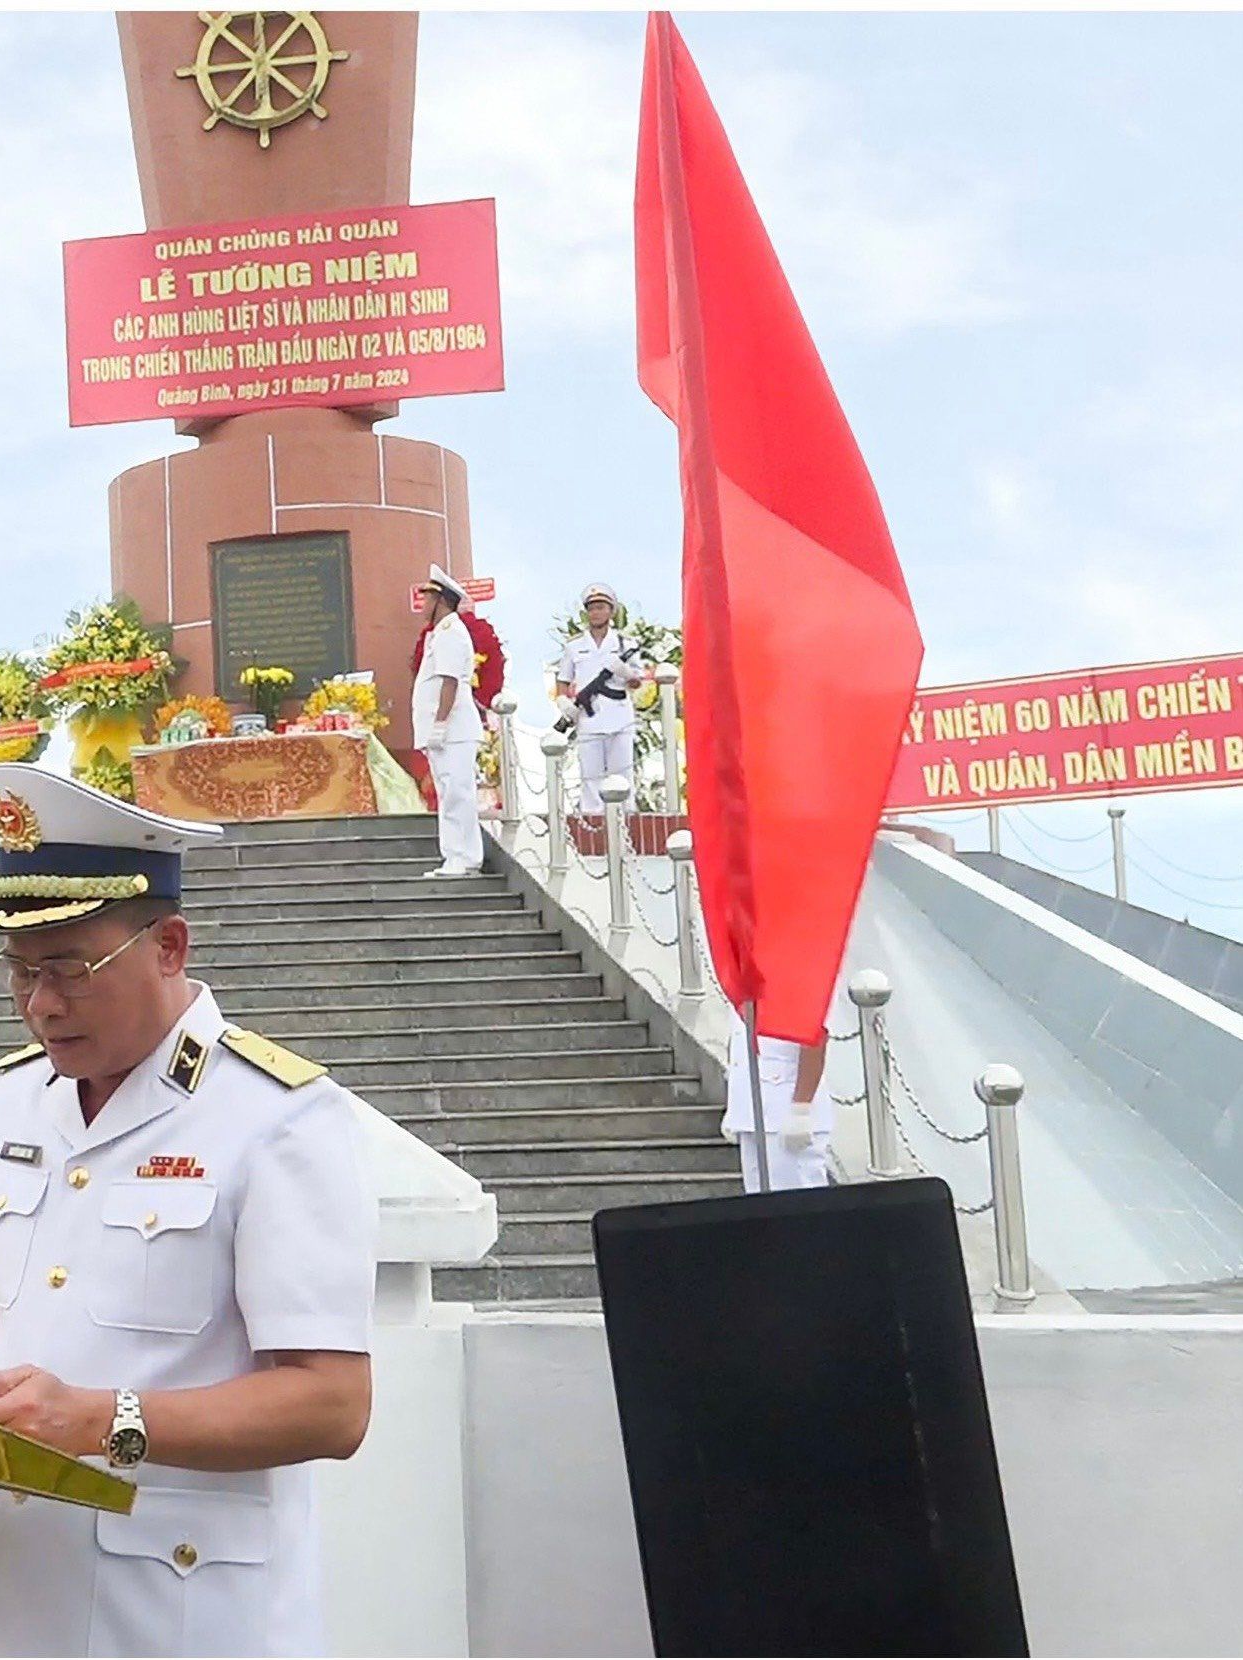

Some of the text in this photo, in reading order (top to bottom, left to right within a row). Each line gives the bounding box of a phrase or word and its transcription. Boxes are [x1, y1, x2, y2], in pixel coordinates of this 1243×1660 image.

[155, 219, 398, 260] QUÂN CHỦNG HẢI QUÂN
[140, 251, 418, 303] LỄ TƯỞNG NIỆM
[113, 288, 449, 342] CÁC ANH HÙNG LIỆT SĨ VÀ NHÂN DÂN HI SINH
[81, 355, 132, 384] TRONG
[135, 344, 180, 379] CHIẾN
[183, 340, 234, 373] THẮNG
[237, 337, 277, 372] TRẬN
[316, 330, 358, 362] NGÀY
[361, 334, 382, 359] 02
[384, 326, 406, 356] VÀ
[409, 324, 487, 355] 05/8/1964
[157, 369, 409, 408] Quảng Bình, ngày 31 tháng 7 năm 2024
[902, 700, 925, 745] Ý
[932, 699, 1008, 745] NIỆM
[1014, 698, 1051, 733] 60
[1058, 685, 1130, 728] NĂM
[1136, 668, 1232, 720] CHIẾN
[922, 756, 962, 797] VÀ
[968, 750, 1057, 797] QUÂN,
[1063, 742, 1128, 785] DÂN
[1134, 729, 1217, 779] MIỀN
